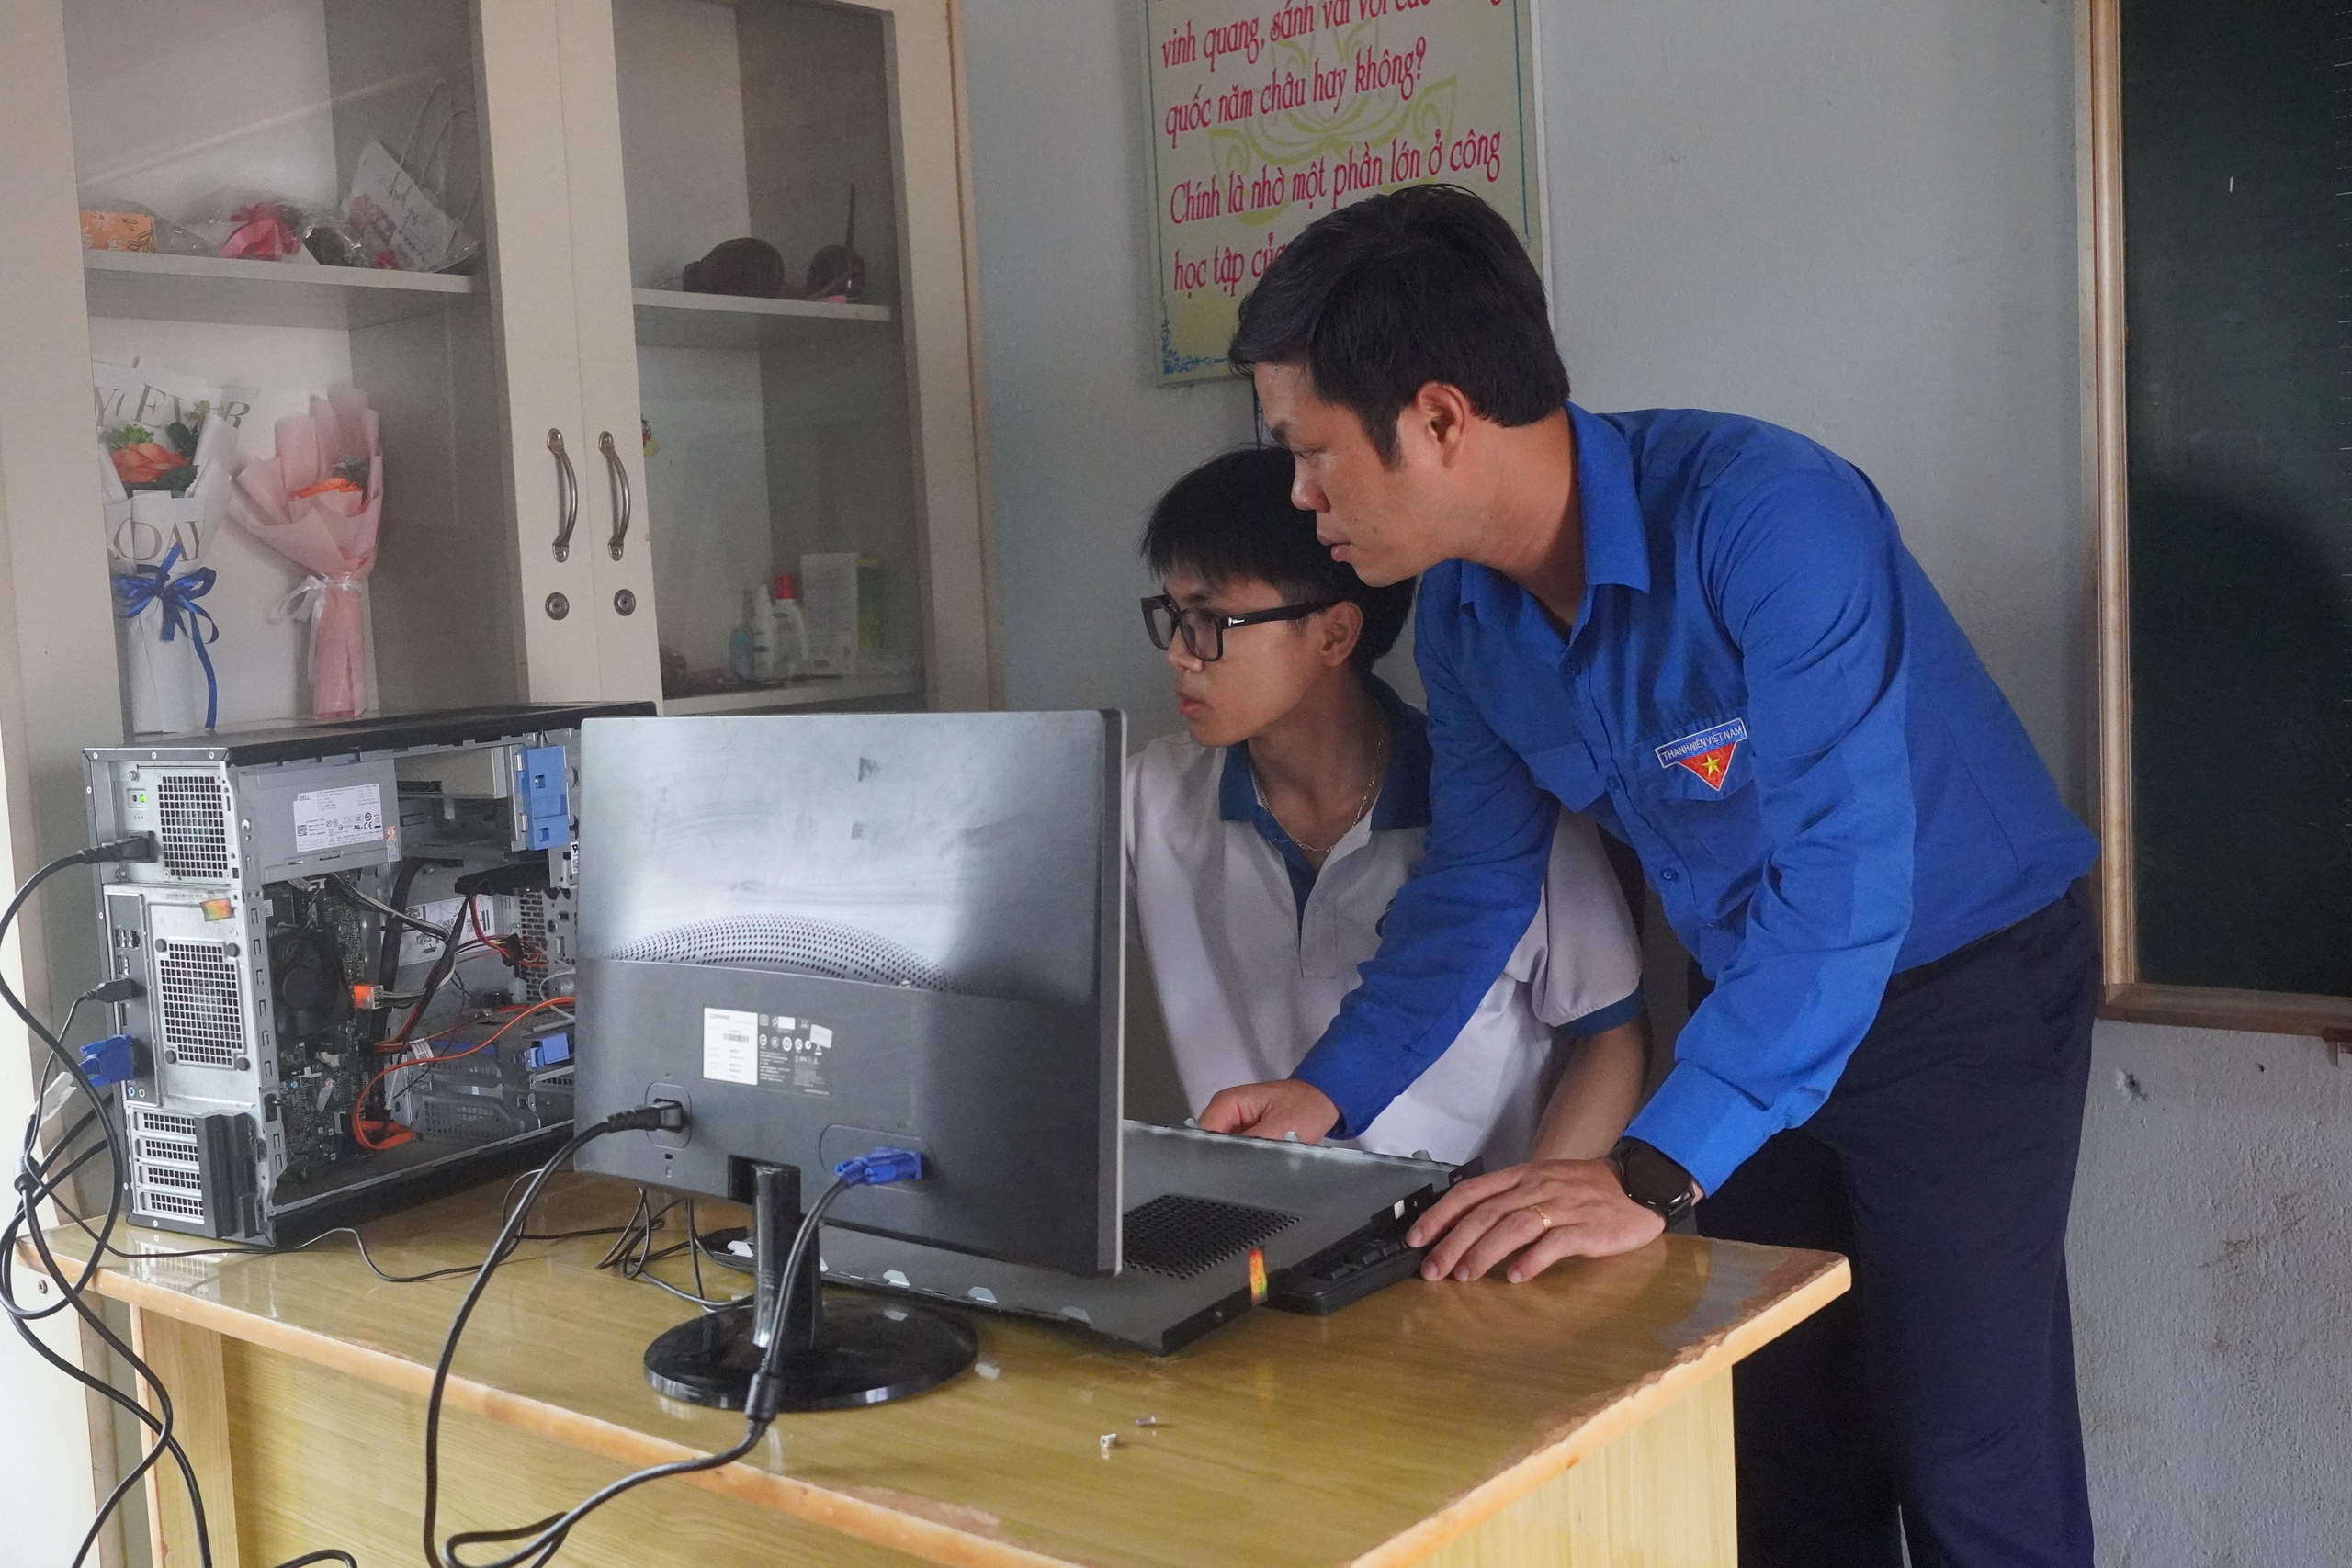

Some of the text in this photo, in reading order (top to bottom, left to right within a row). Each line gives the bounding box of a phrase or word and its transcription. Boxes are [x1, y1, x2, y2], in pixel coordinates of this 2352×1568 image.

[1161, 18, 1196, 68] vinh
[1203, 17, 1265, 73] quang,
[1270, 0, 1314, 42] sánh
[1165, 36, 1426, 149] quốc năm châu hay không?
[1170, 128, 1501, 224] Chính là nhờ một phần lớn ở công
[1174, 249, 1207, 299] học
[1214, 245, 1245, 297] tập
[1659, 744, 1690, 761] THANH
[1689, 737, 1707, 751] NIÊN
[1723, 725, 1743, 740] NAM
